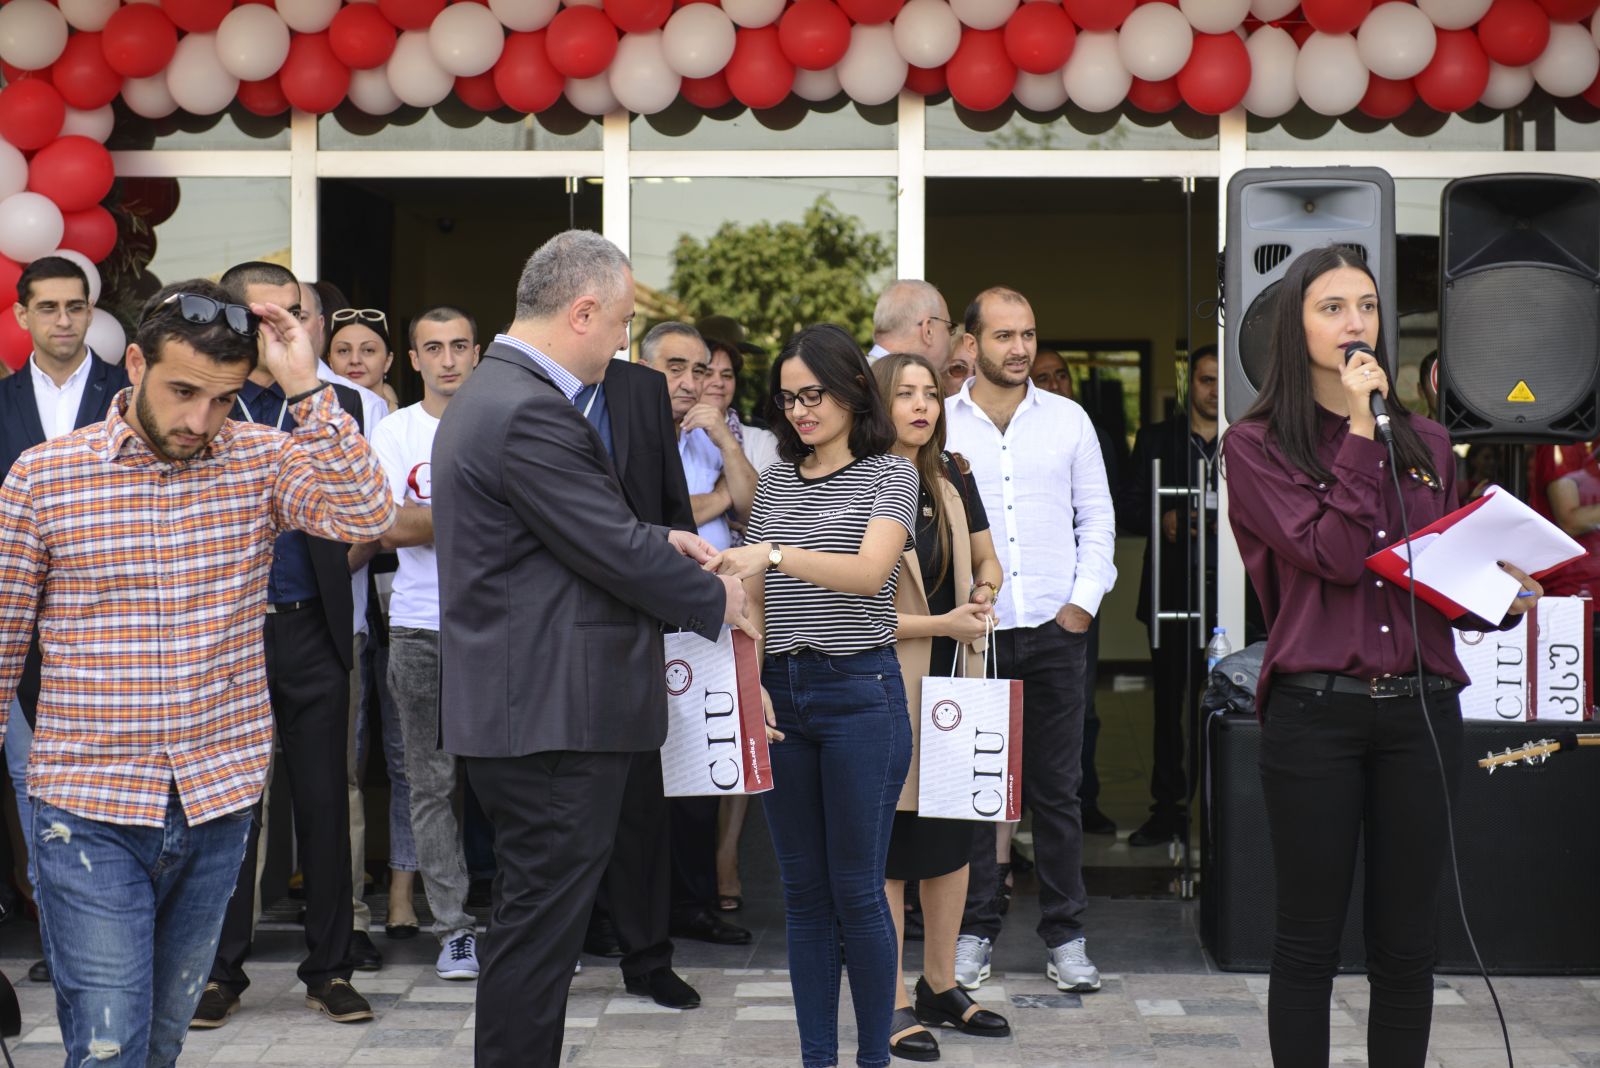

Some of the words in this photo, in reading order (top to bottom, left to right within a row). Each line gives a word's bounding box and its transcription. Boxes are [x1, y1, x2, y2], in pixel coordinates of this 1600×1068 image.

[1495, 642, 1523, 719] CIU
[1549, 644, 1580, 715] კსუ
[705, 687, 740, 790] CIU
[971, 726, 1005, 818] CIU
